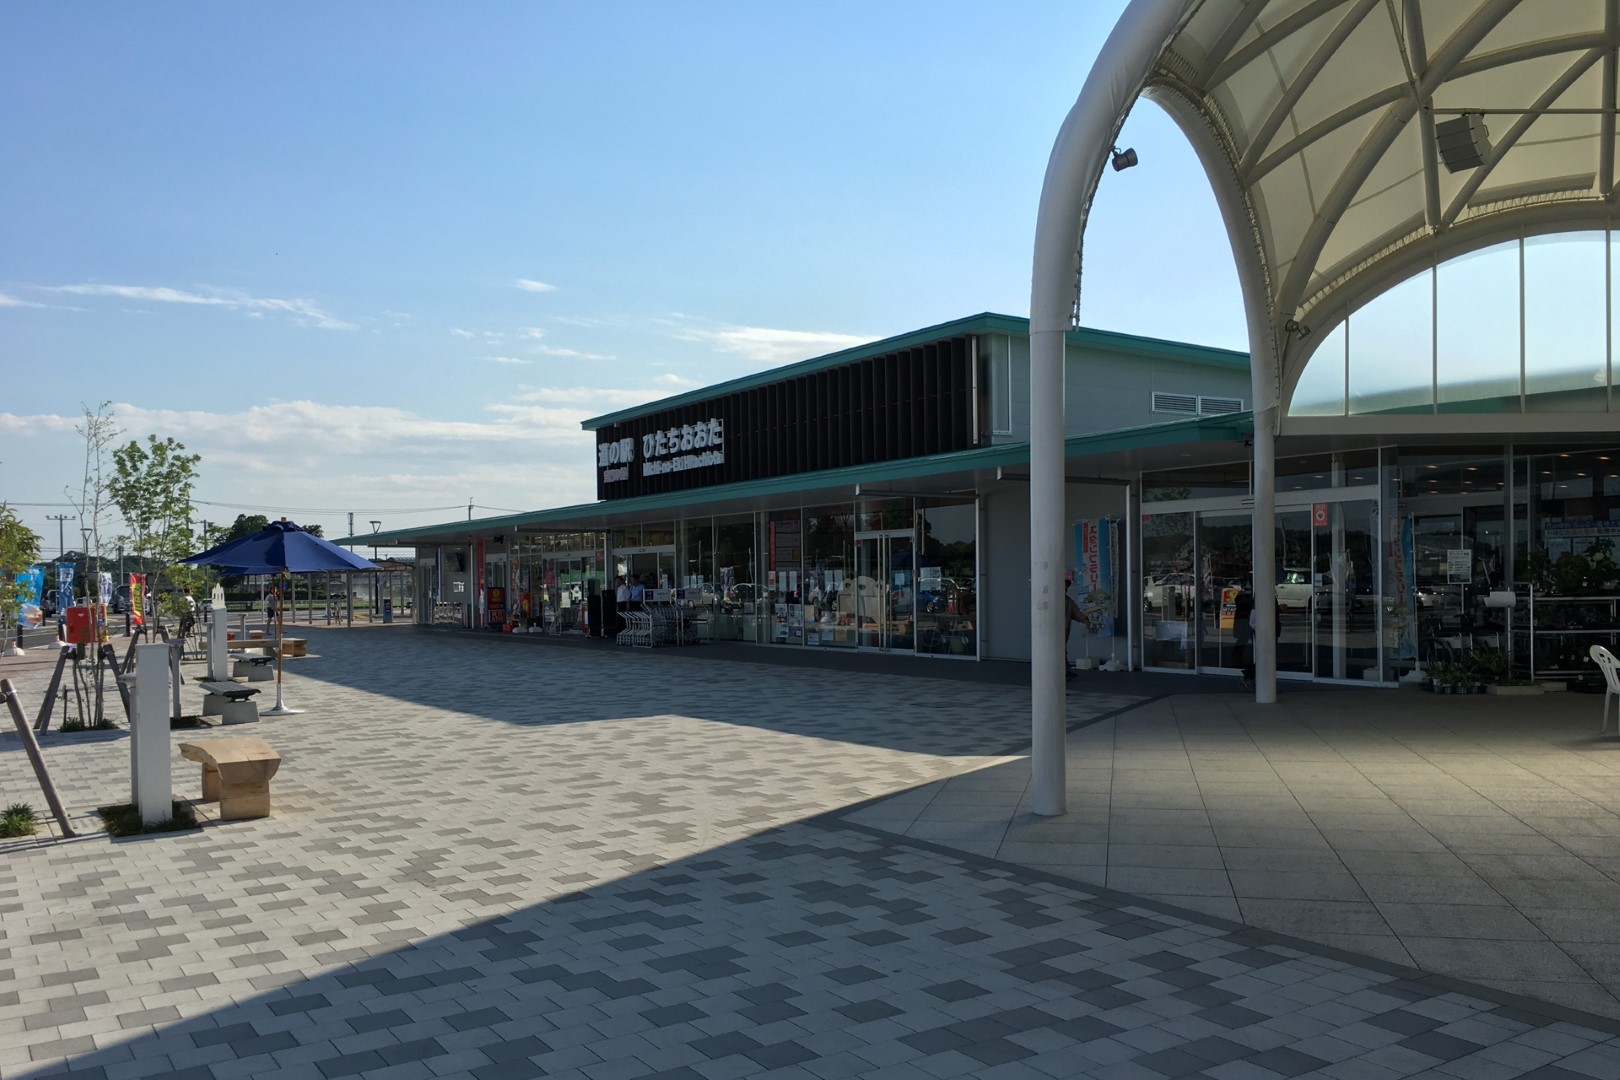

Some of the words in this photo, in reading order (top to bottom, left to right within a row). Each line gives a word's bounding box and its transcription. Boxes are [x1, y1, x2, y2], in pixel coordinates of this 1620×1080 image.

[598, 438, 634, 467] 道の駅
[642, 418, 722, 458] ひたちおおた
